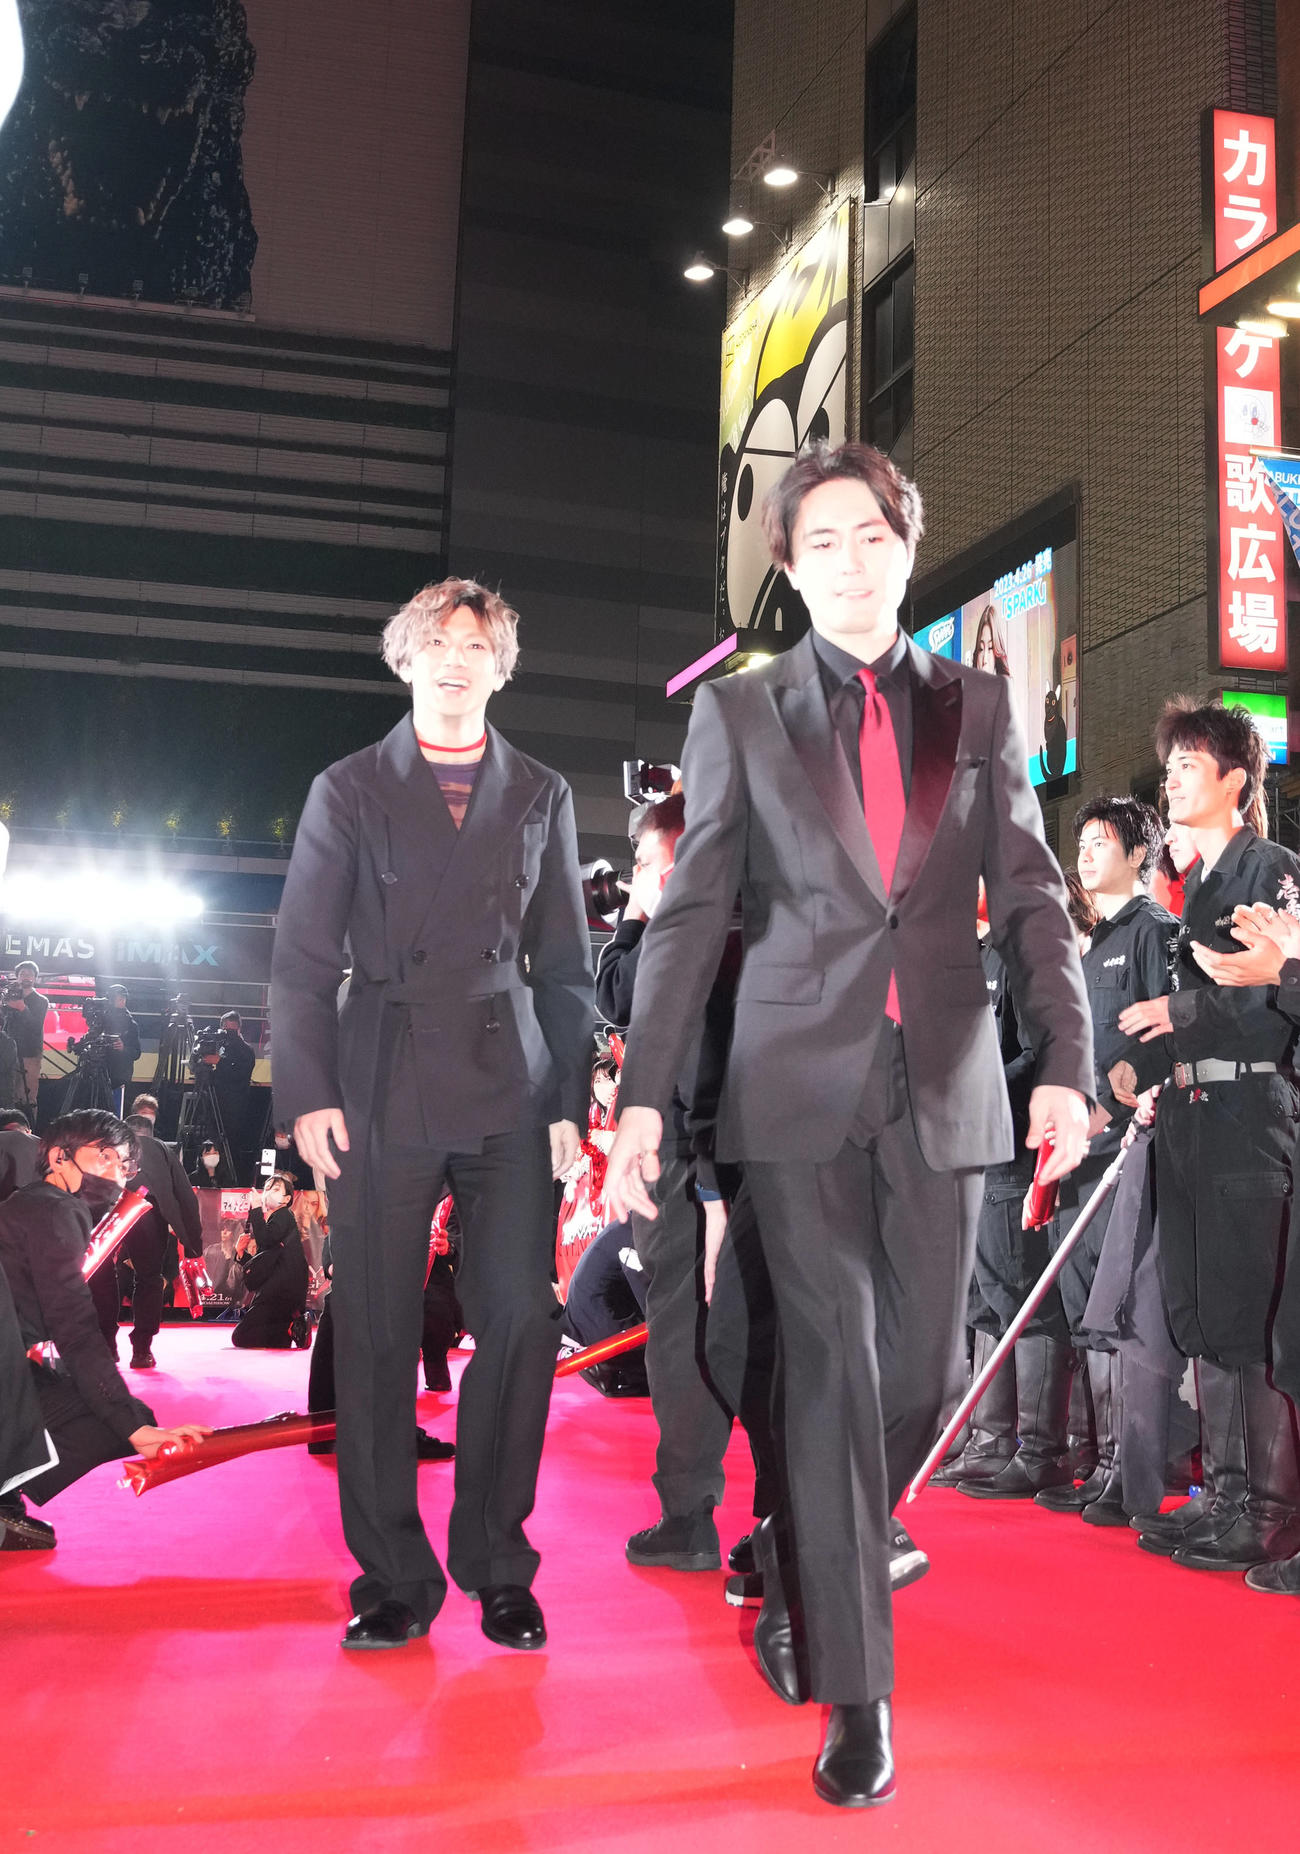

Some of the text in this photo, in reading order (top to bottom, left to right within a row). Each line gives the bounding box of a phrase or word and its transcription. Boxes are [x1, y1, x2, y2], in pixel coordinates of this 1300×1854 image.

[1223, 130, 1273, 378] カラケ
[1225, 454, 1279, 653] 歌広場
